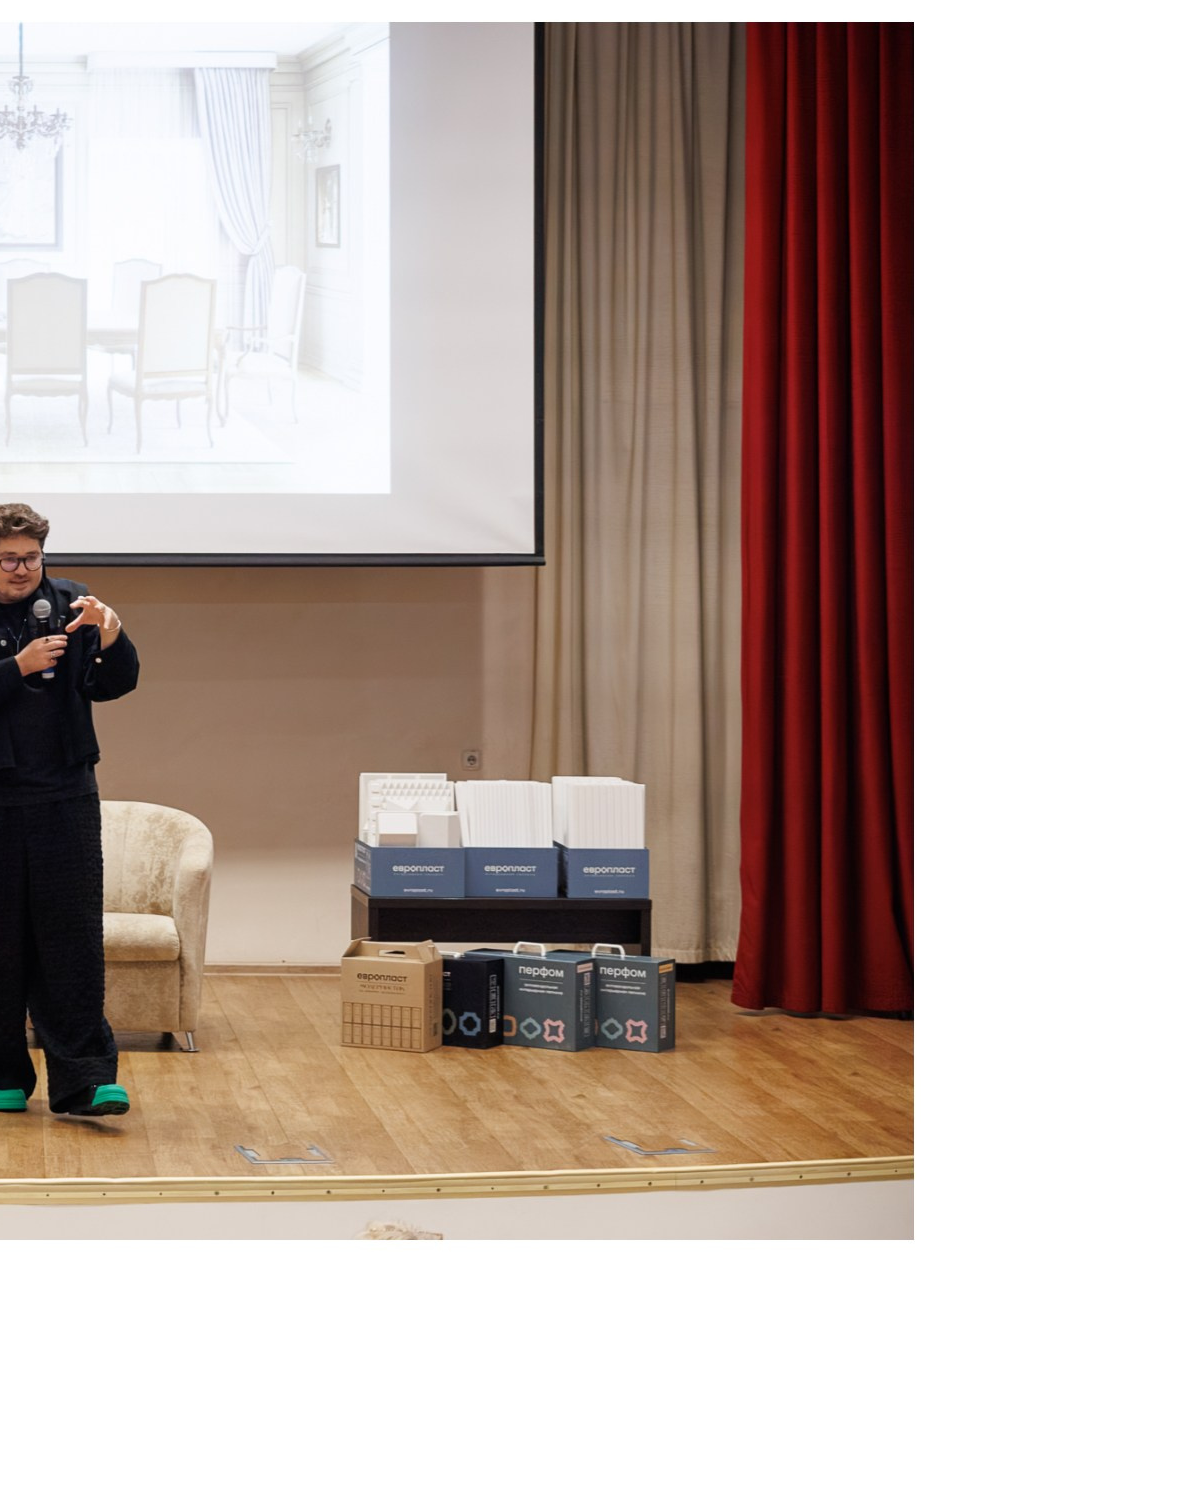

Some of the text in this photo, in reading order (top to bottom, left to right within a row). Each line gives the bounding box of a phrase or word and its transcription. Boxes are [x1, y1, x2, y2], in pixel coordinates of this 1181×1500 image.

[392, 864, 445, 874] европласт
[484, 864, 537, 874] европласт
[582, 866, 636, 876] европласт
[356, 972, 408, 982] европласт
[518, 966, 564, 978] перфом
[599, 966, 647, 978] перфом
